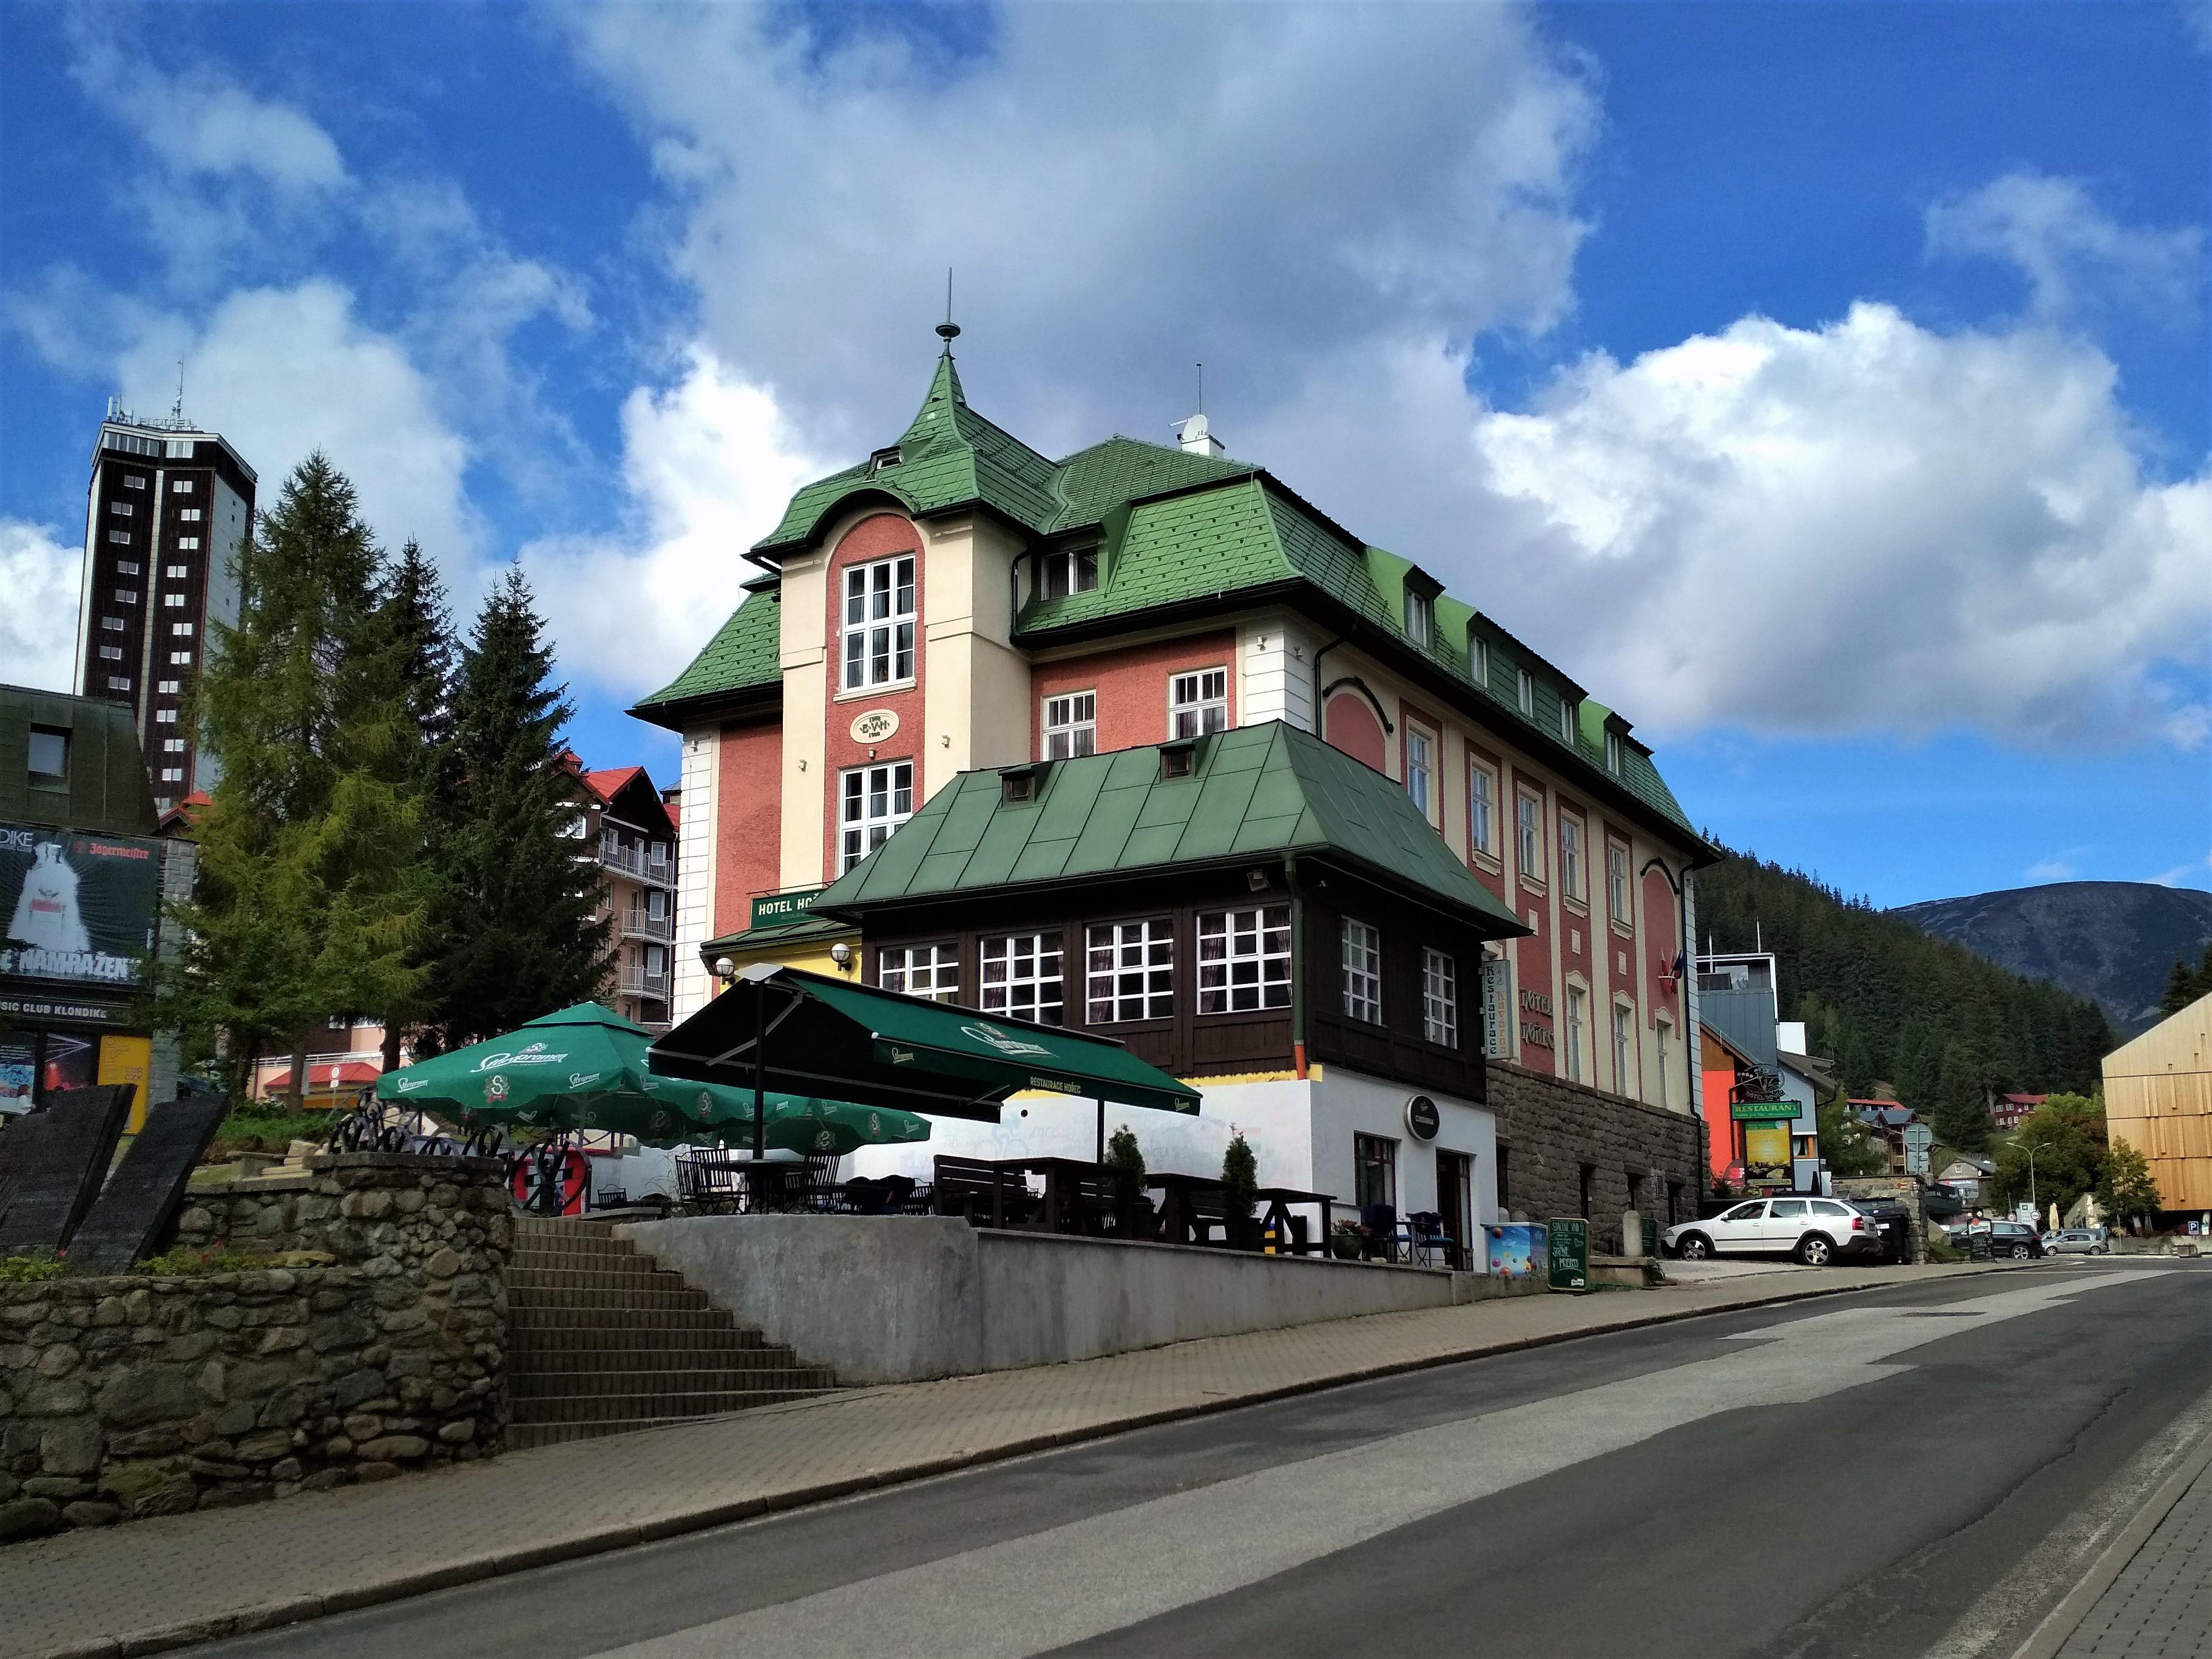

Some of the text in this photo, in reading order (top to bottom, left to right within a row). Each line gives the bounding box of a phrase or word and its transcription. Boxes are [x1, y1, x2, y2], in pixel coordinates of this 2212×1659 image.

[759, 900, 793, 915] HOTEL
[0, 1000, 19, 1012] SIC
[22, 1003, 50, 1014] CLUB
[1486, 966, 1497, 1054] Restaurace
[1030, 1076, 1081, 1094] RESTAURACE HOŘEC
[1736, 1104, 1797, 1113] RESTAURANT
[2190, 1223, 2197, 1231] P
